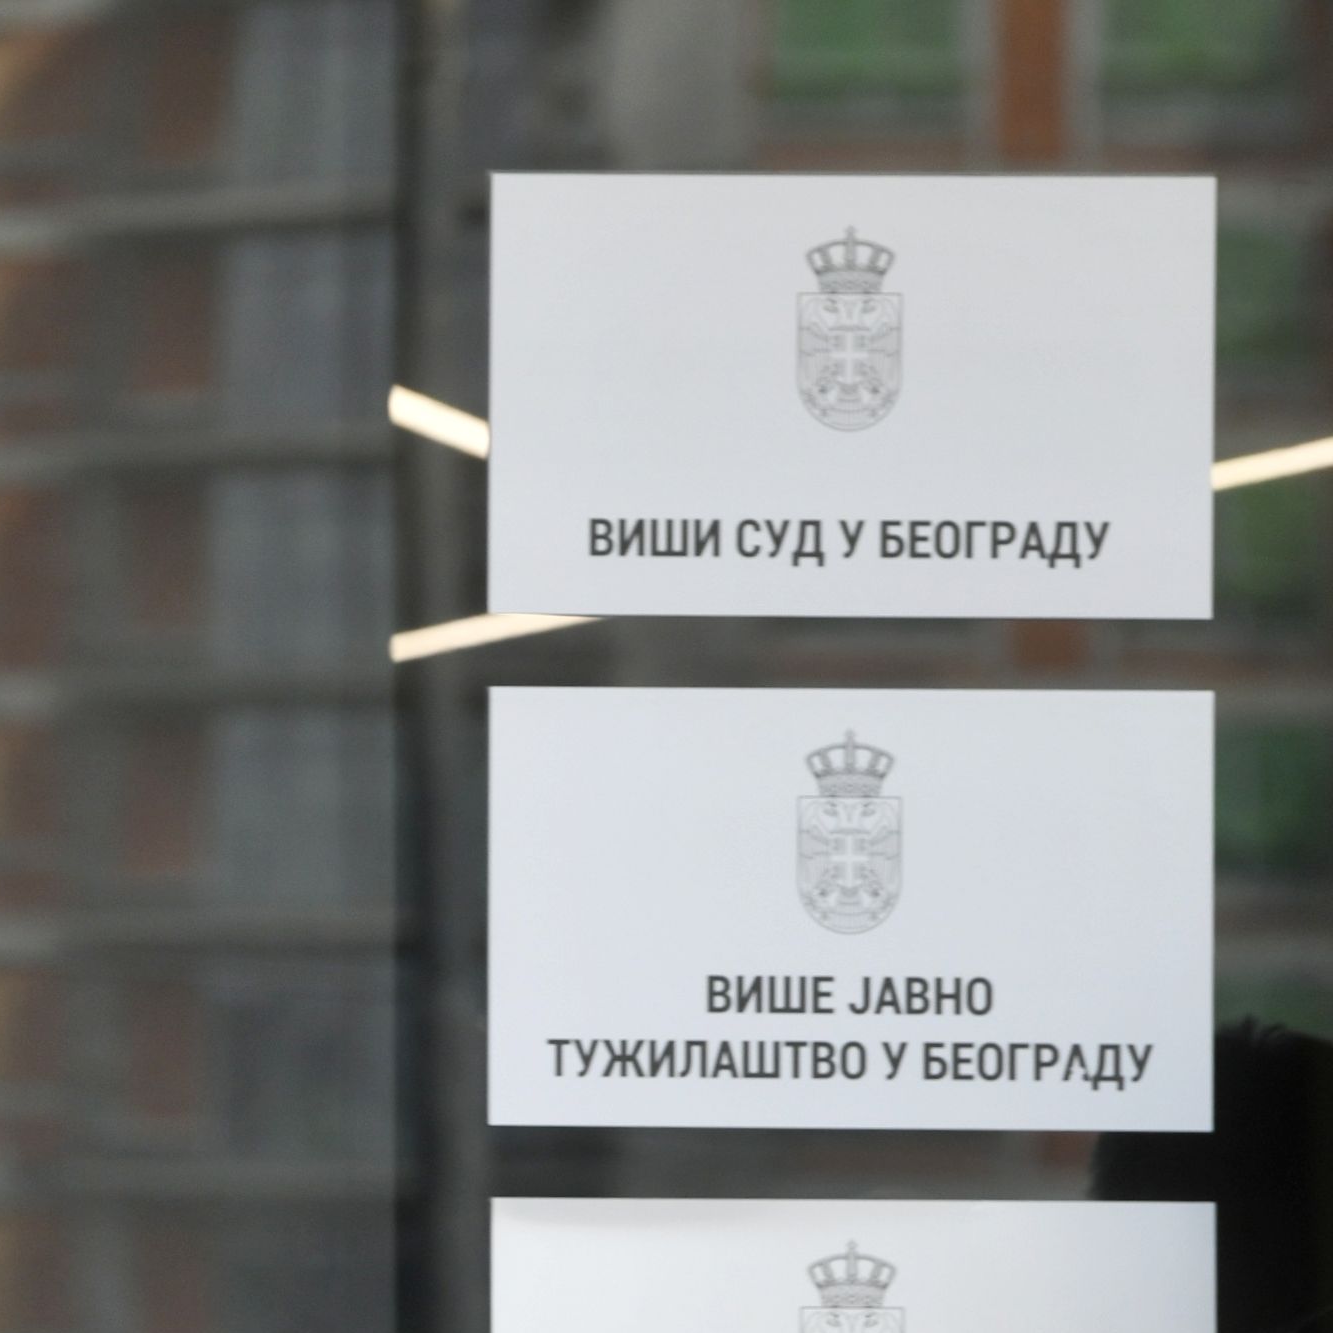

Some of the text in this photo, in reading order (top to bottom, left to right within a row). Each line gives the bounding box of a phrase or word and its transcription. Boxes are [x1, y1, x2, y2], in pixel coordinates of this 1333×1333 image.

[589, 518, 1110, 570] ВИШИ СУД У БЕОГРАДУ
[707, 975, 993, 1017] ВИШЕ ЈАВНО
[547, 1038, 1153, 1092] ТУЖИЛАШТВО У БЕОГРАДУ
